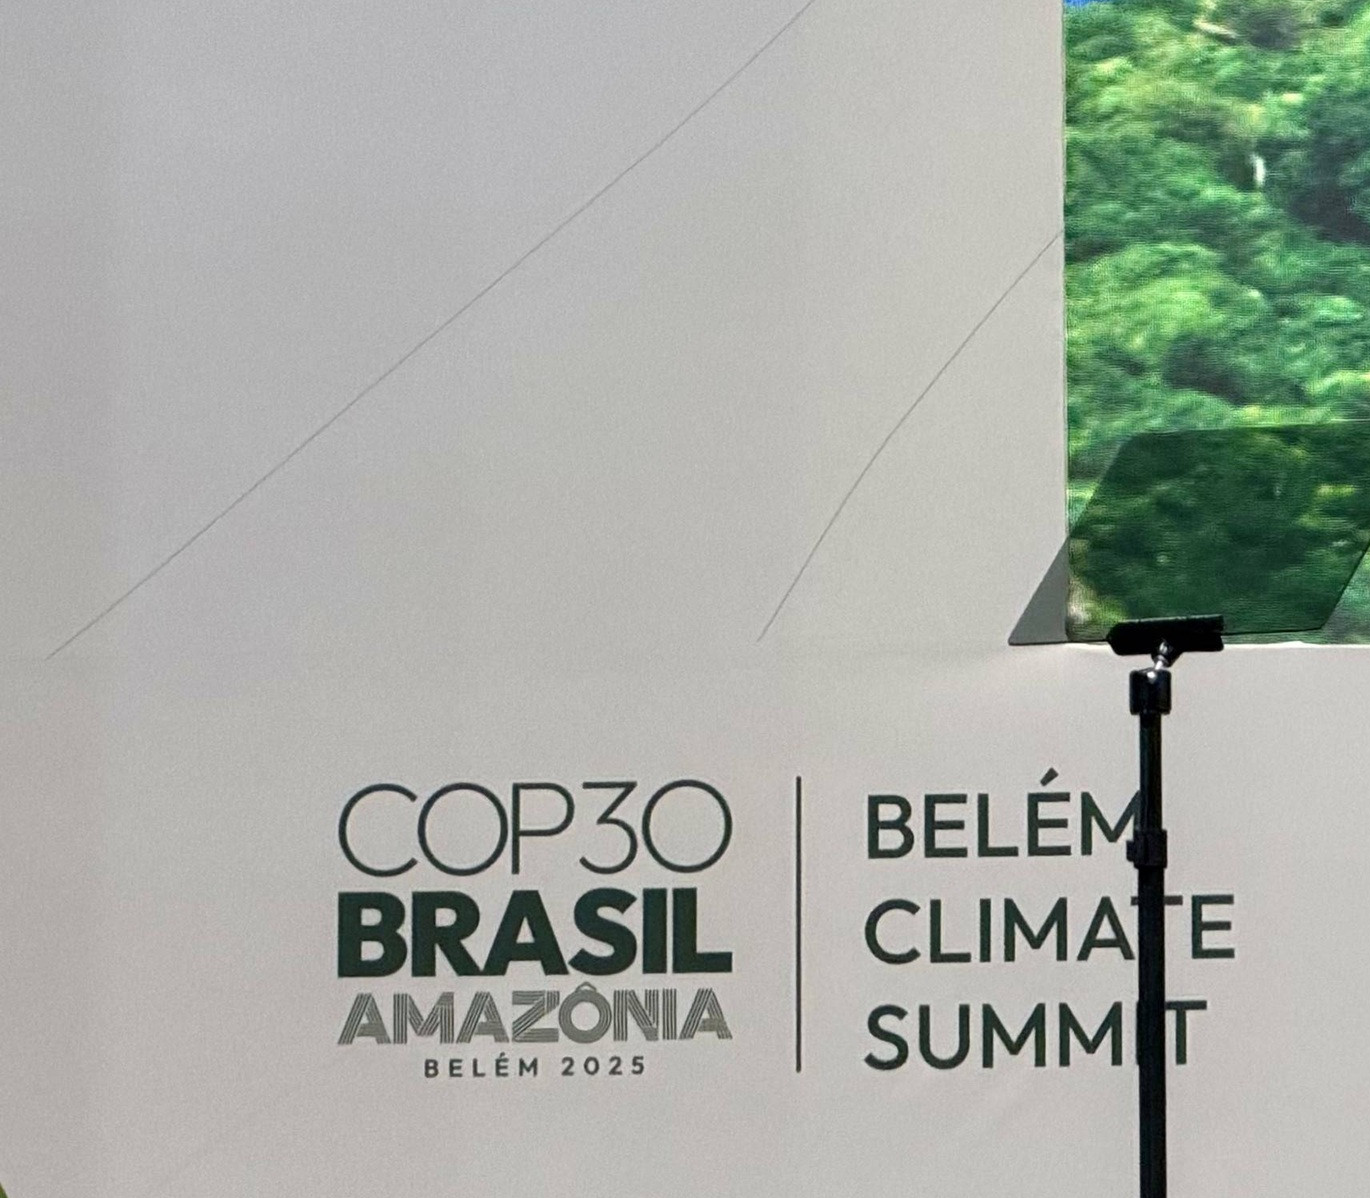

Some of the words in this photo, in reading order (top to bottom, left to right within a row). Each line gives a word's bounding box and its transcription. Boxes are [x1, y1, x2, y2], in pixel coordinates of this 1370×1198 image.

[337, 779, 733, 877] COP30
[867, 768, 1140, 860] BELÉM
[337, 888, 733, 978] BRASIL
[337, 981, 733, 1046] AMAZÔNIA
[864, 1000, 1208, 1071] SUMMT
[424, 1051, 538, 1079] BELÉM
[561, 1055, 645, 1077] 2025
